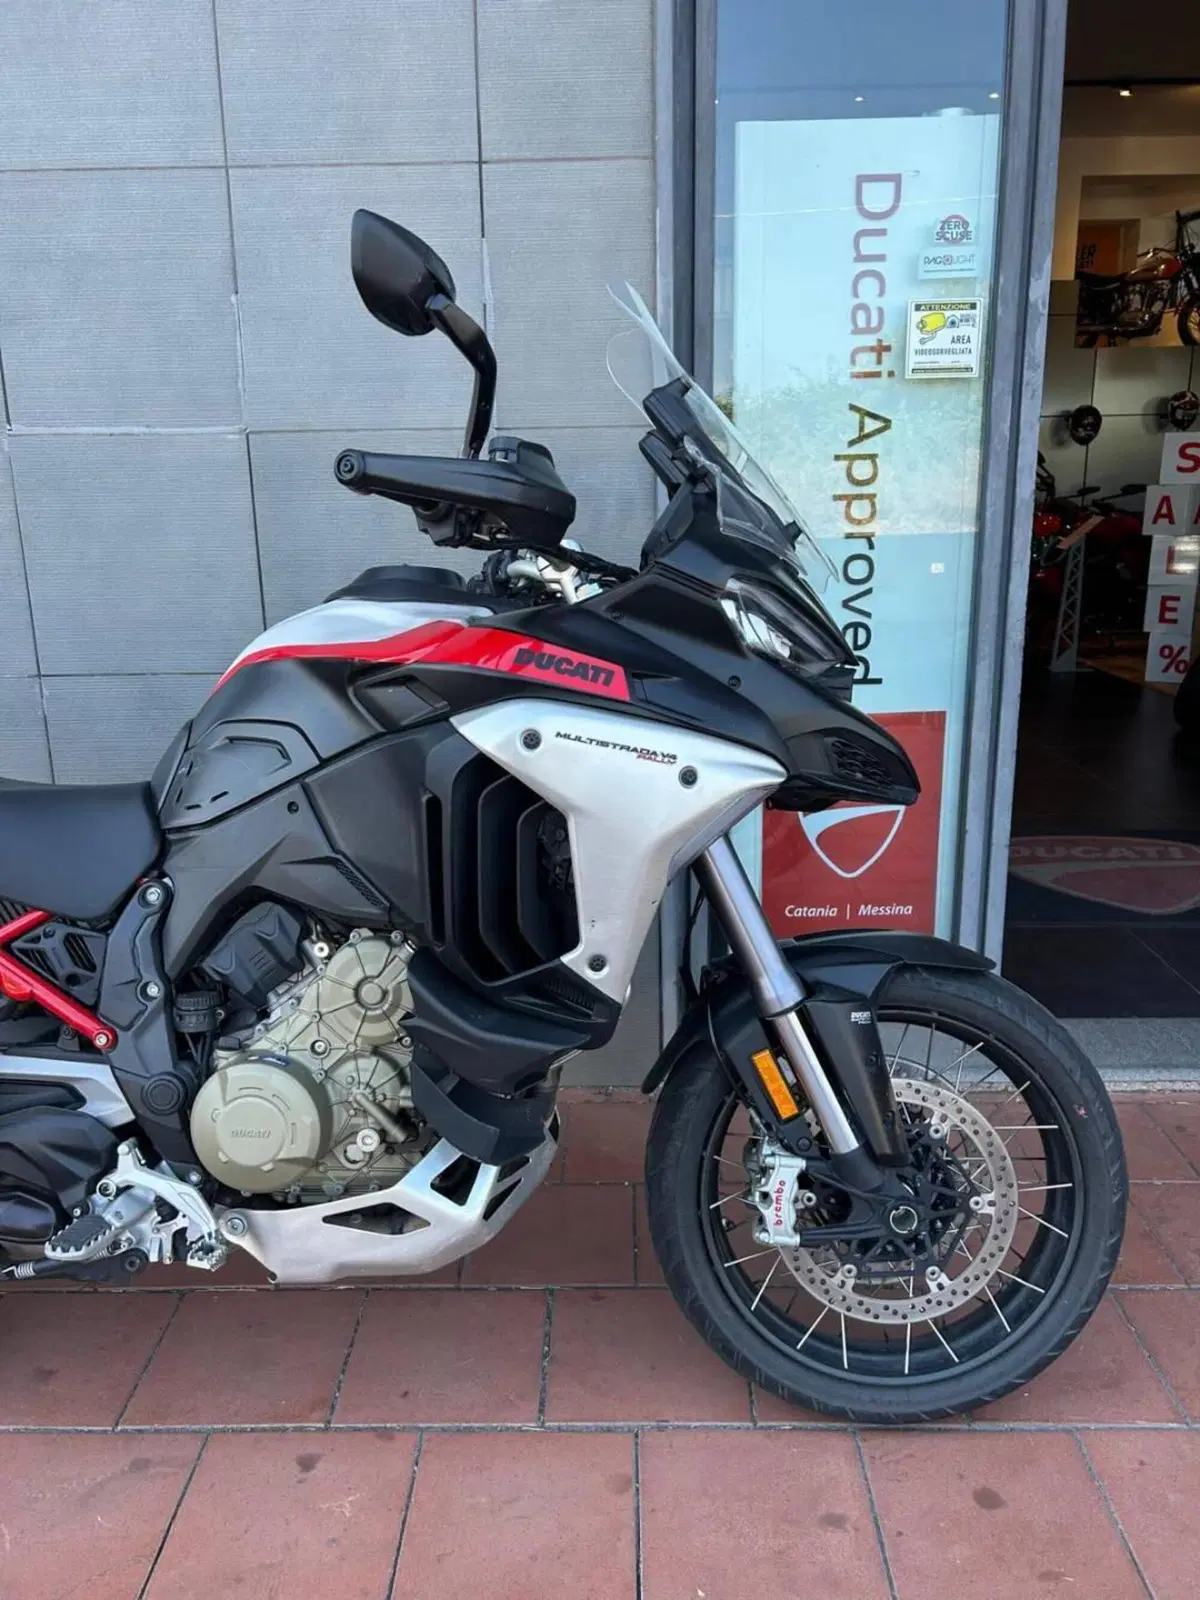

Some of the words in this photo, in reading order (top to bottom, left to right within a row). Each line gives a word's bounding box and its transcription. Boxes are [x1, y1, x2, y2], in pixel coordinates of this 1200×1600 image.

[940, 220, 970, 231] ZERO
[935, 230, 973, 241] SCUSE
[849, 173, 903, 380] Ducati
[919, 302, 972, 312] ATTENZIONE
[950, 335, 972, 345] AREA
[914, 347, 972, 357] VIDEOSORVEGLIATA
[832, 402, 893, 685] Approved
[514, 647, 616, 688] DUCATI
[555, 731, 660, 758] MULTISTRADA
[636, 753, 678, 766] RALLY
[784, 904, 838, 918] Catania
[858, 902, 913, 917] Messina
[773, 1179, 787, 1227] brembo
